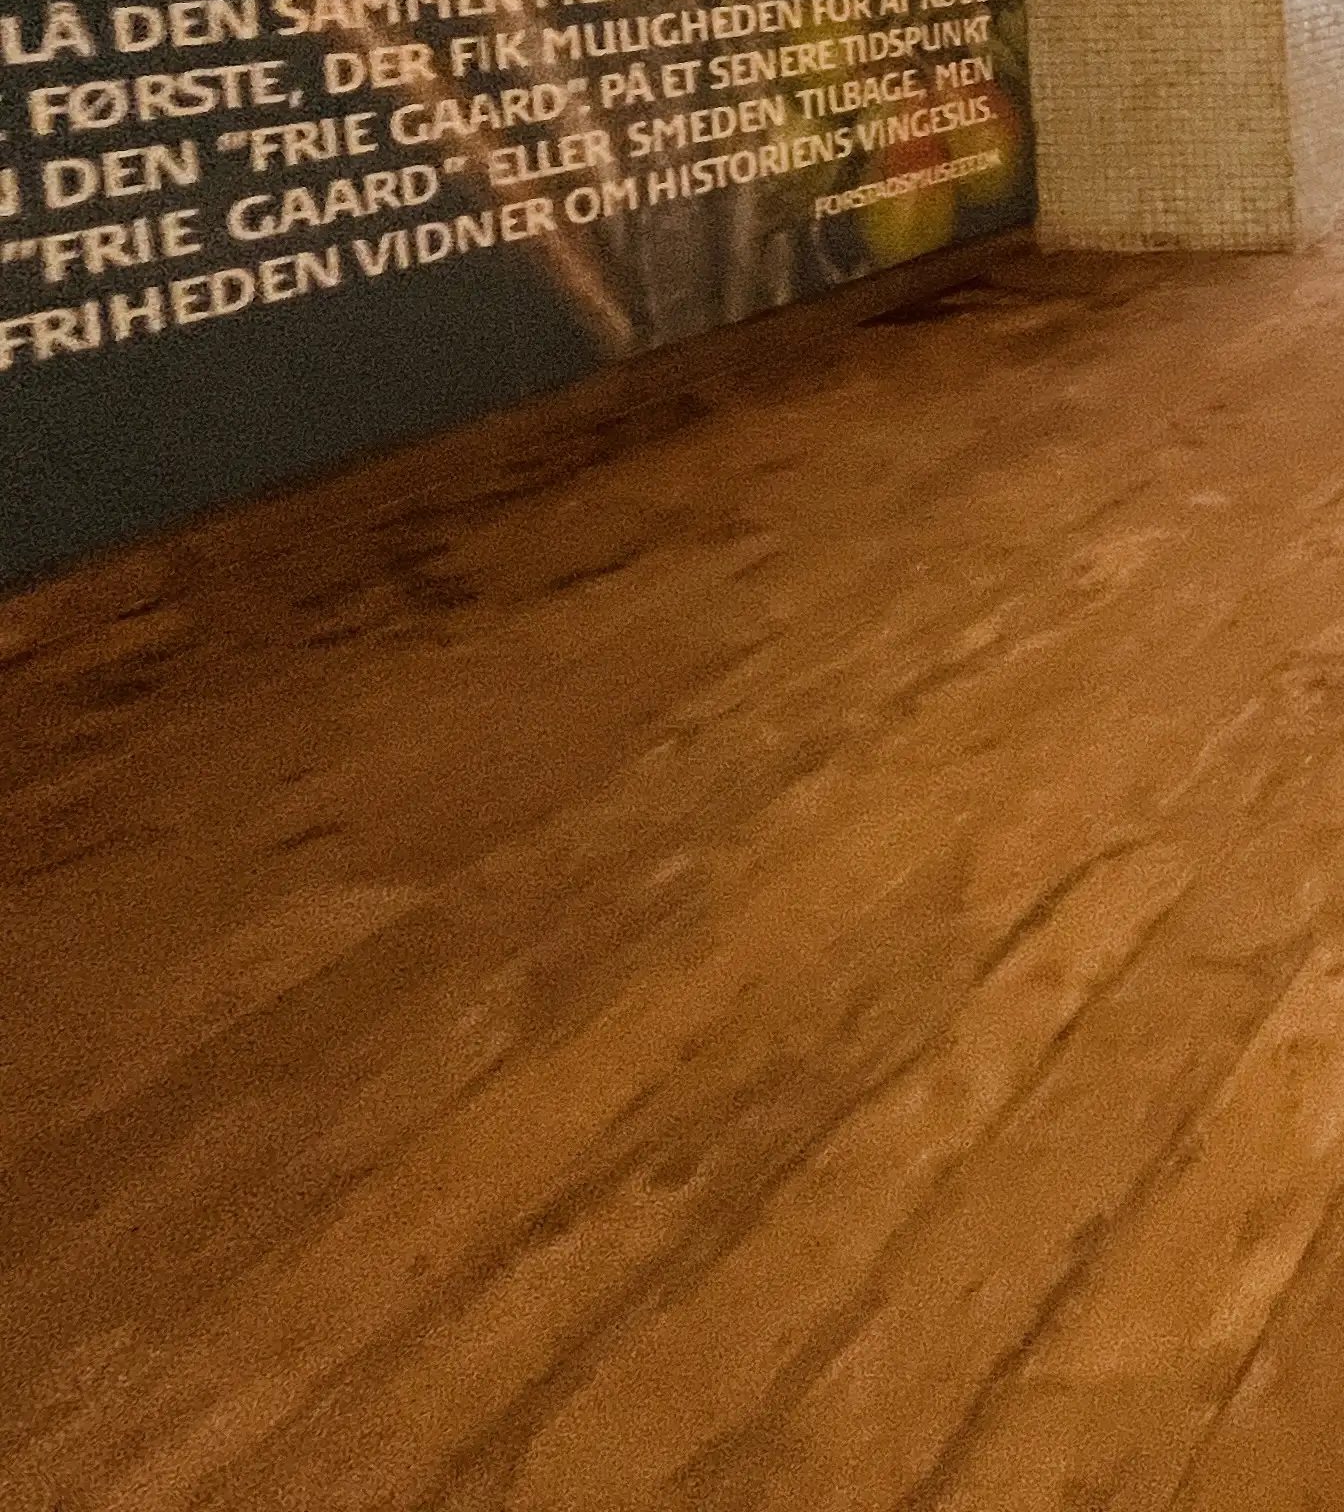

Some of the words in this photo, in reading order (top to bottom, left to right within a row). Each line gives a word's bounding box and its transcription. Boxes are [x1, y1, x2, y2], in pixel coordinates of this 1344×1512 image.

[2, 2, 96, 64] LÅ
[29, 60, 303, 135] FØRSTE,
[324, 44, 437, 94] DER
[452, 29, 531, 76] FIK
[543, 0, 802, 64] MULIGHEDEN
[43, 140, 200, 209] DEN
[600, 62, 654, 109] PÅ
[661, 60, 702, 98] ET
[709, 40, 837, 90] SENERE
[843, 15, 991, 66] TIDSPUNKT
[489, 129, 616, 186] ELLER
[627, 94, 785, 158] SMEDEN
[935, 55, 993, 91] MEN
[0, 244, 341, 372] FRIHEDEN
[352, 197, 556, 276] VIDNER
[564, 176, 639, 224] OM
[648, 126, 853, 206] HISTORIENS
